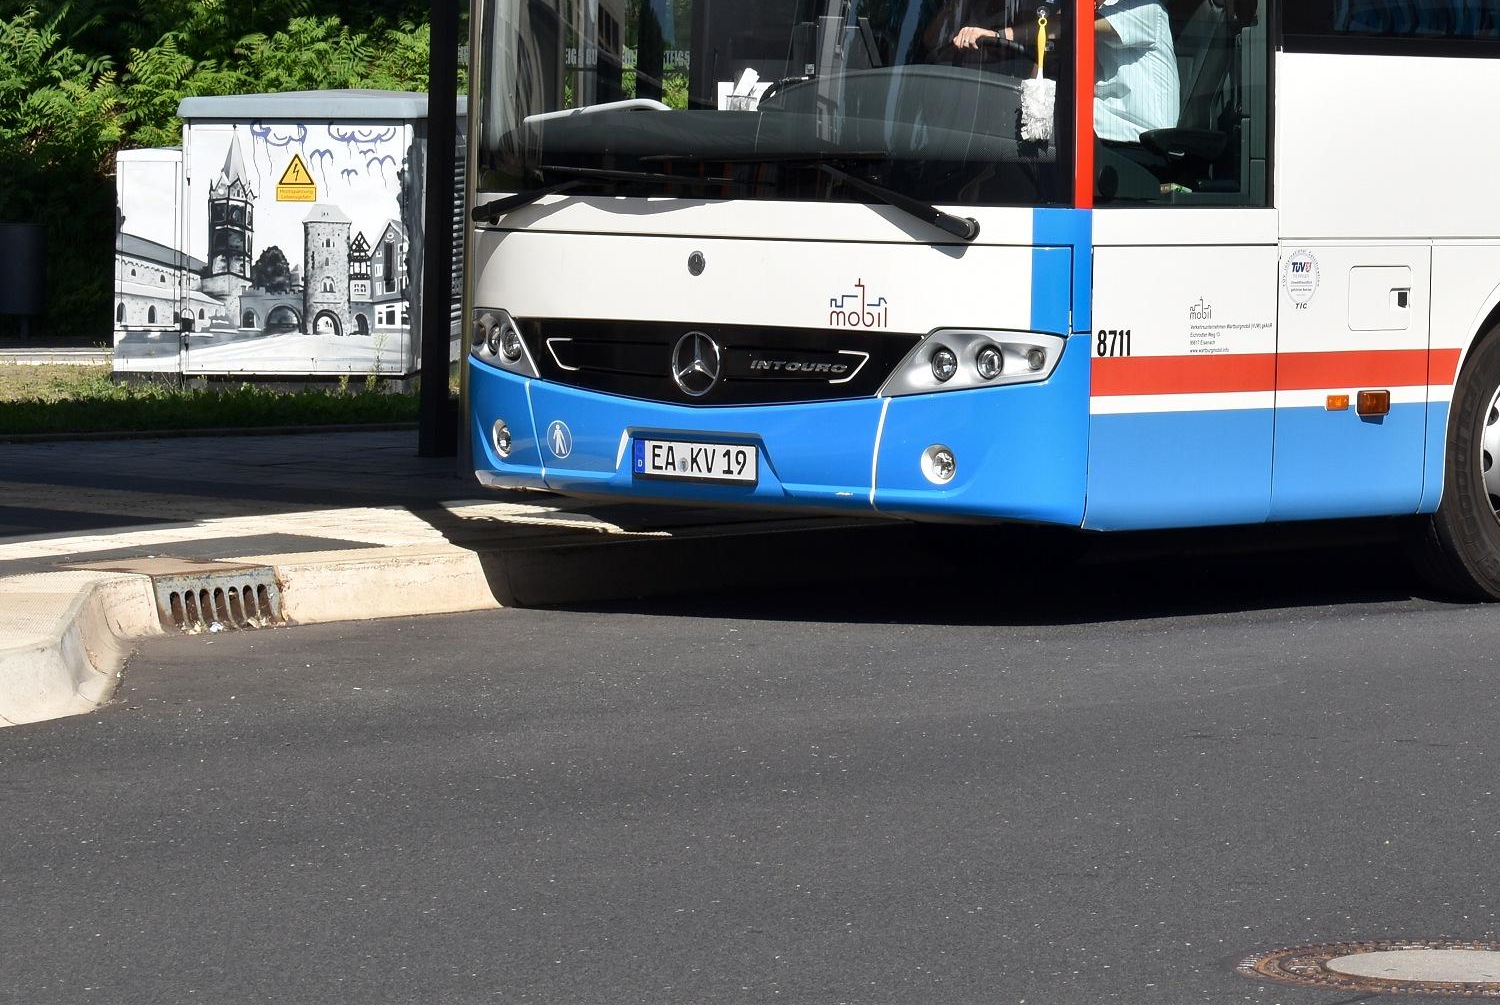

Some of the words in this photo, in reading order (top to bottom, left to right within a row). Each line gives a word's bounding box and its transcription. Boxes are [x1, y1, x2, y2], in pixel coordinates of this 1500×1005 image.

[830, 285, 888, 328] mobil
[1189, 298, 1212, 320] mobil
[1097, 329, 1131, 357] 8711
[750, 359, 848, 373] INTOURO
[652, 444, 677, 471] EA
[690, 447, 716, 474] KV
[722, 449, 747, 476] 19
